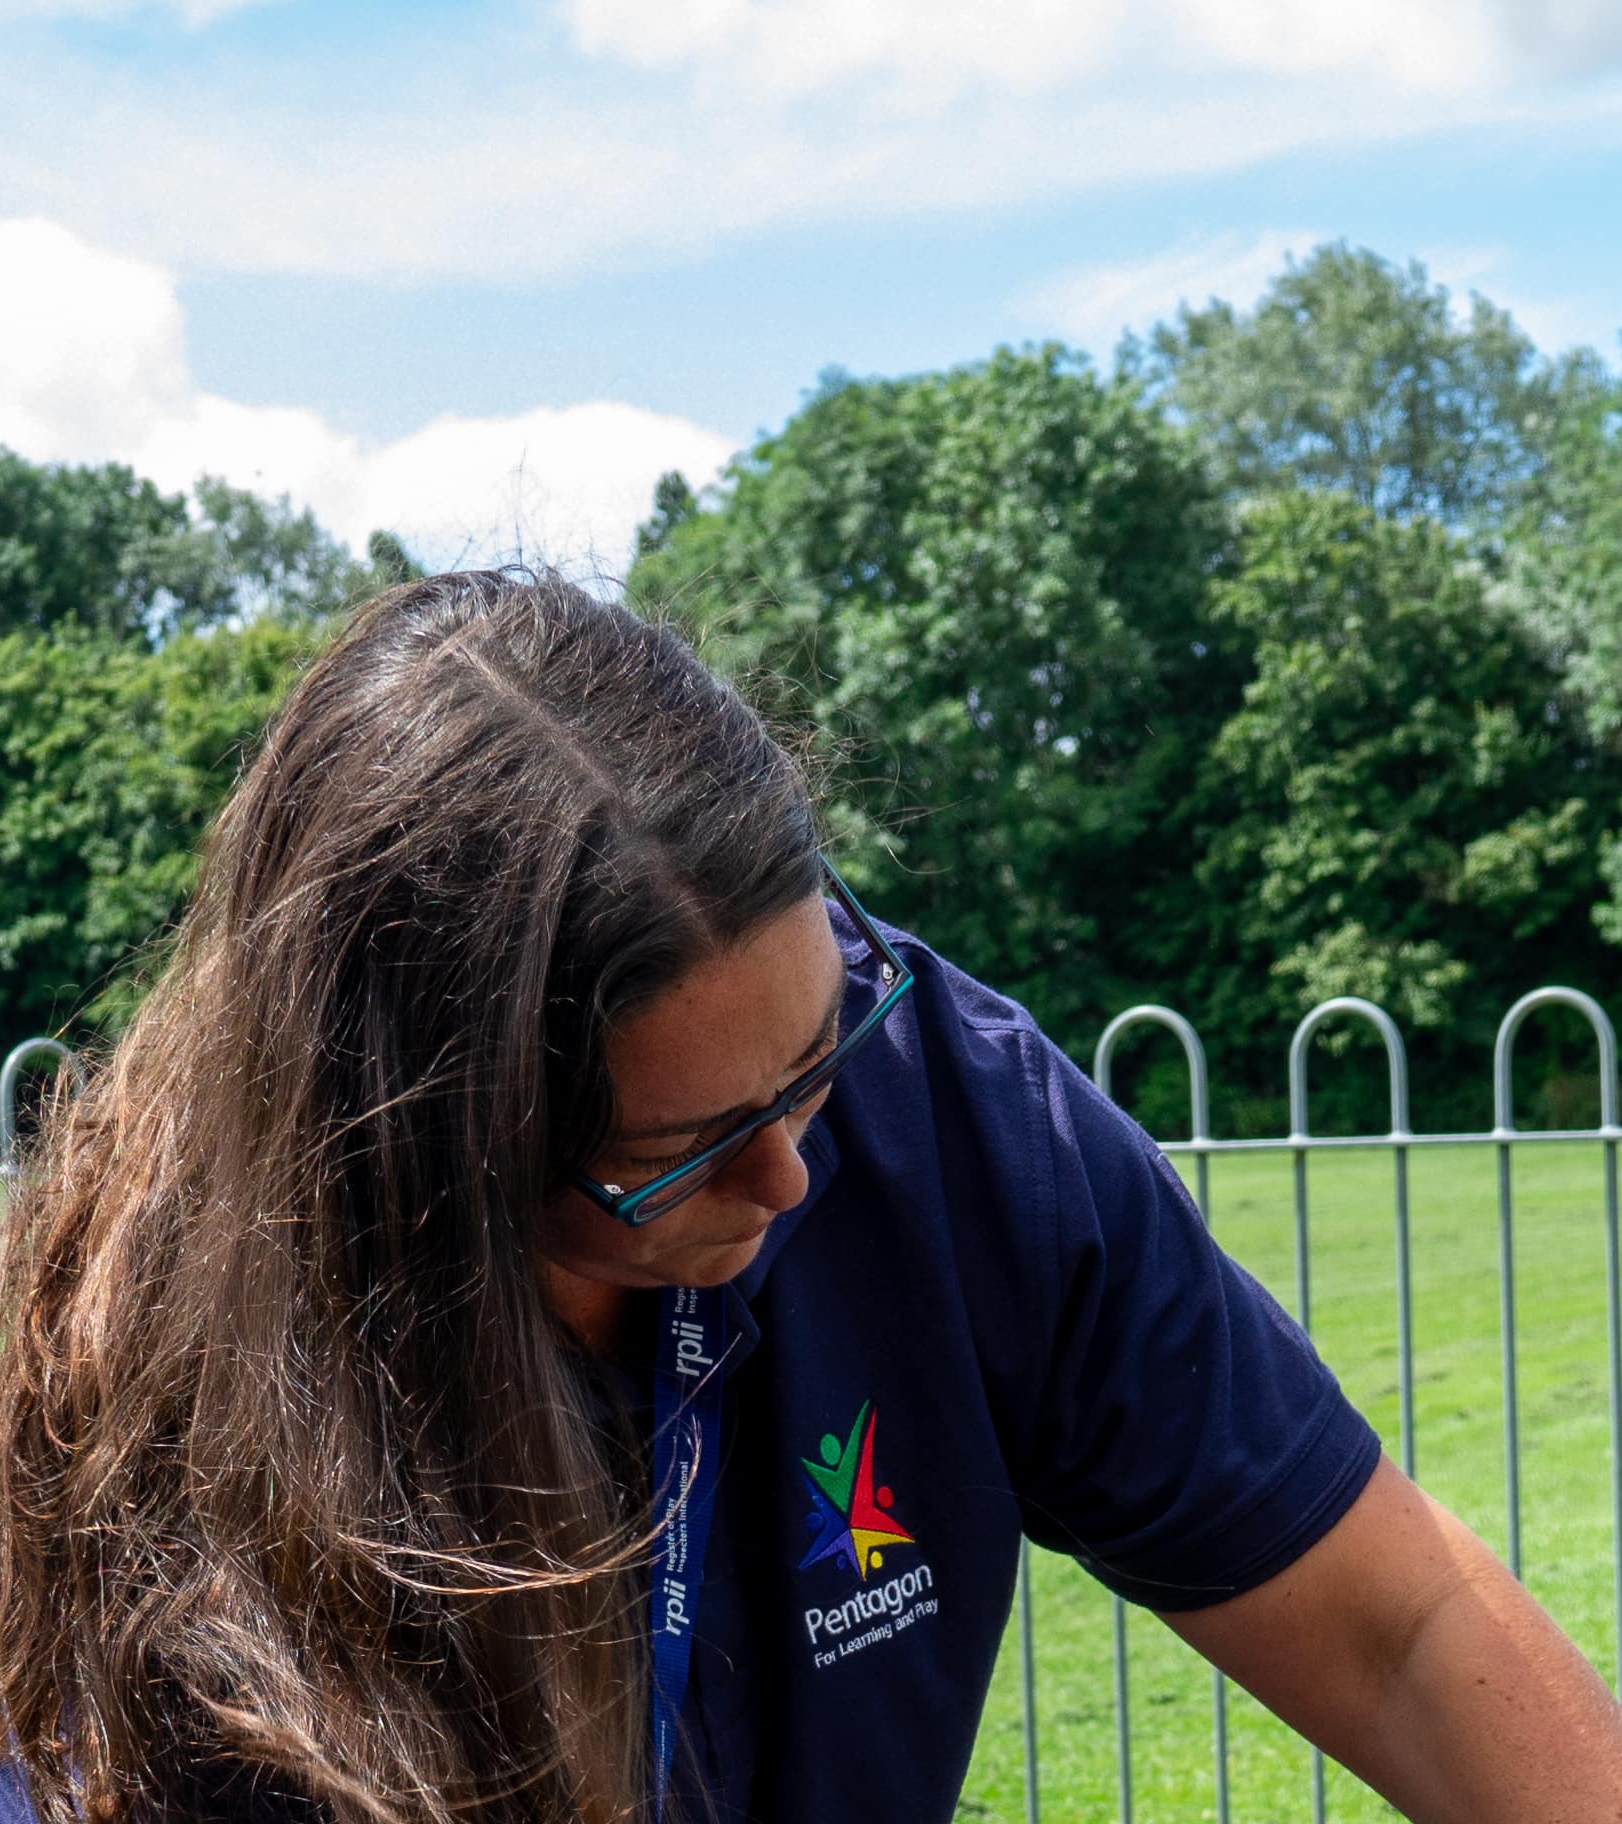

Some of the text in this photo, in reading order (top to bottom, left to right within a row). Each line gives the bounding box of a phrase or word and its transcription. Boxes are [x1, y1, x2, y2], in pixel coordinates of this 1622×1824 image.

[674, 1287, 686, 1313] Regis
[687, 1287, 698, 1314] Inspe
[671, 1320, 714, 1377] rpii
[665, 1497, 676, 1517] Play
[677, 1523, 688, 1573] Inspectors
[663, 1577, 691, 1636] rpii
[805, 1564, 933, 1644] Pentagon
[814, 1598, 939, 1669] For Learning and Play
